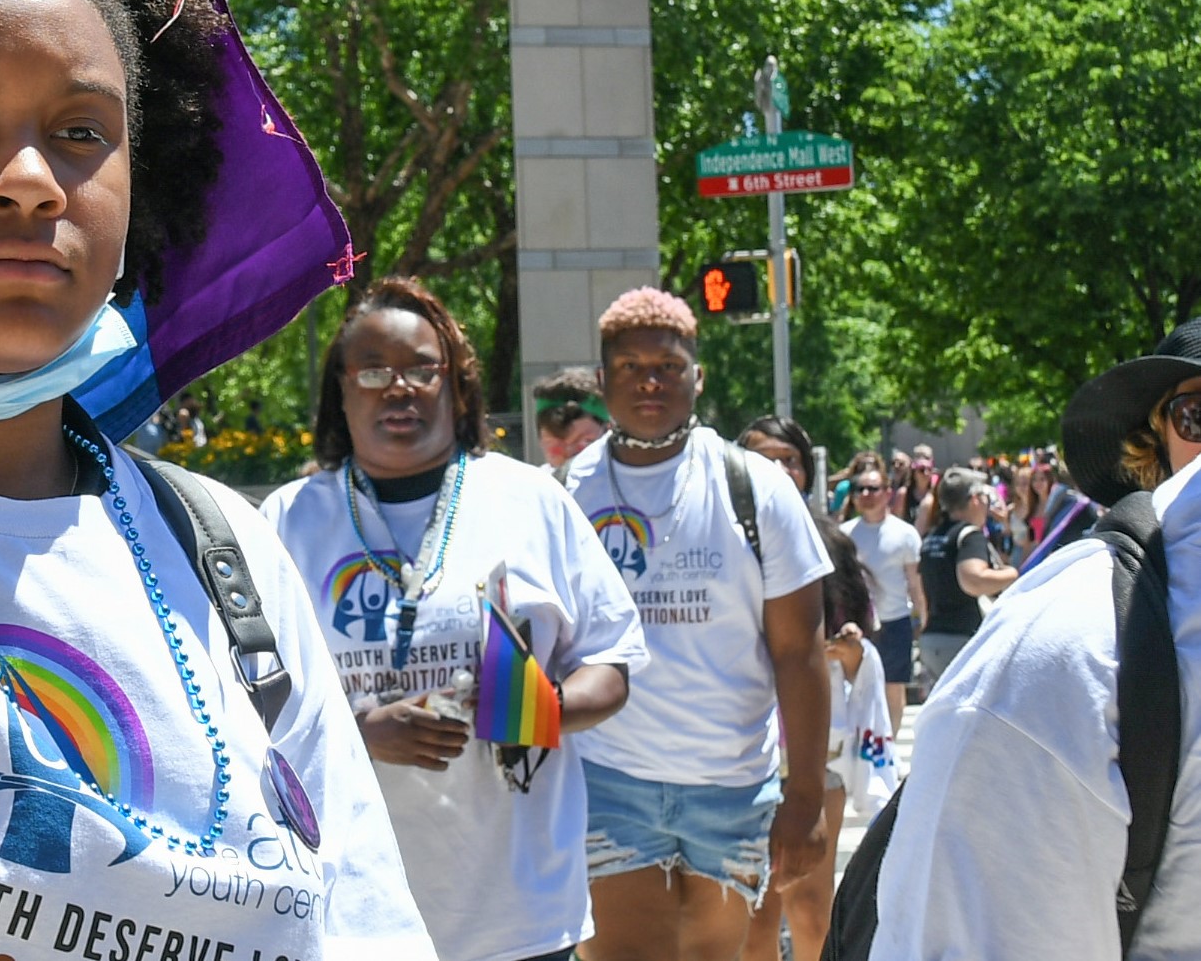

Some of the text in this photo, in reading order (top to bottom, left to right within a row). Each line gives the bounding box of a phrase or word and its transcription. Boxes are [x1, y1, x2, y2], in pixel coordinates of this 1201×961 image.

[701, 143, 847, 175] Independence Mall West
[743, 175, 770, 191] 6th
[774, 170, 823, 189] Street
[675, 547, 723, 570] attic
[335, 649, 384, 670] YOUTH
[391, 642, 458, 667] DSERVE
[164, 859, 265, 909] youth
